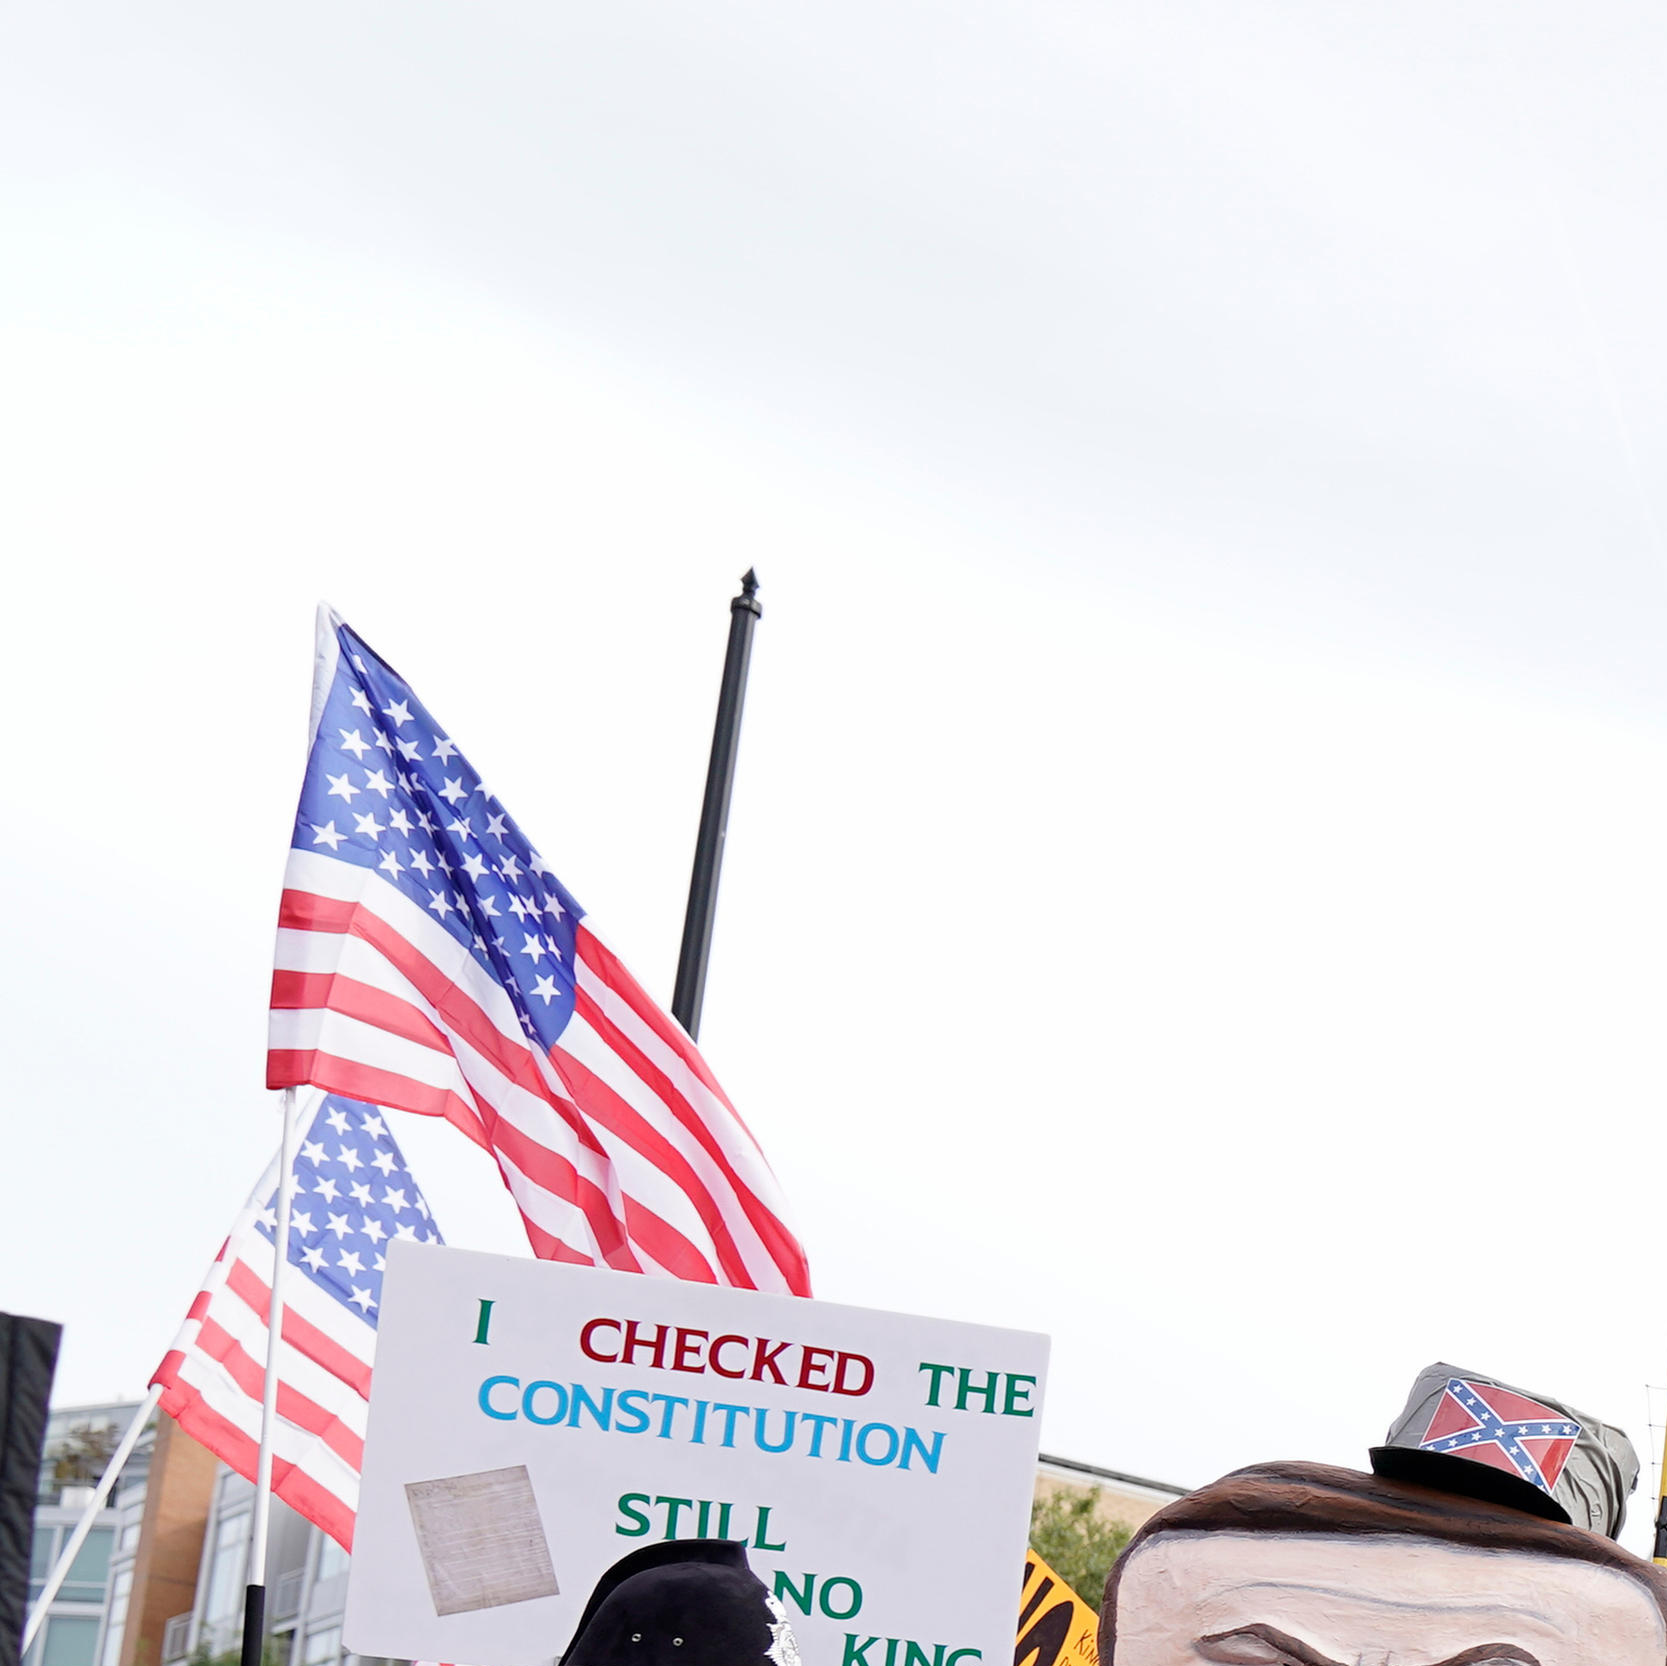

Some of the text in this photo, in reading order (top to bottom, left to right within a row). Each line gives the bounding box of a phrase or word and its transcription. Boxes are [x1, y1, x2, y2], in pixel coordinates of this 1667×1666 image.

[474, 1299, 1037, 1417] I CHECKED THE
[477, 1375, 946, 1475] CONSTITUTION
[616, 1493, 787, 1552] STILL
[774, 1571, 863, 1620] NO
